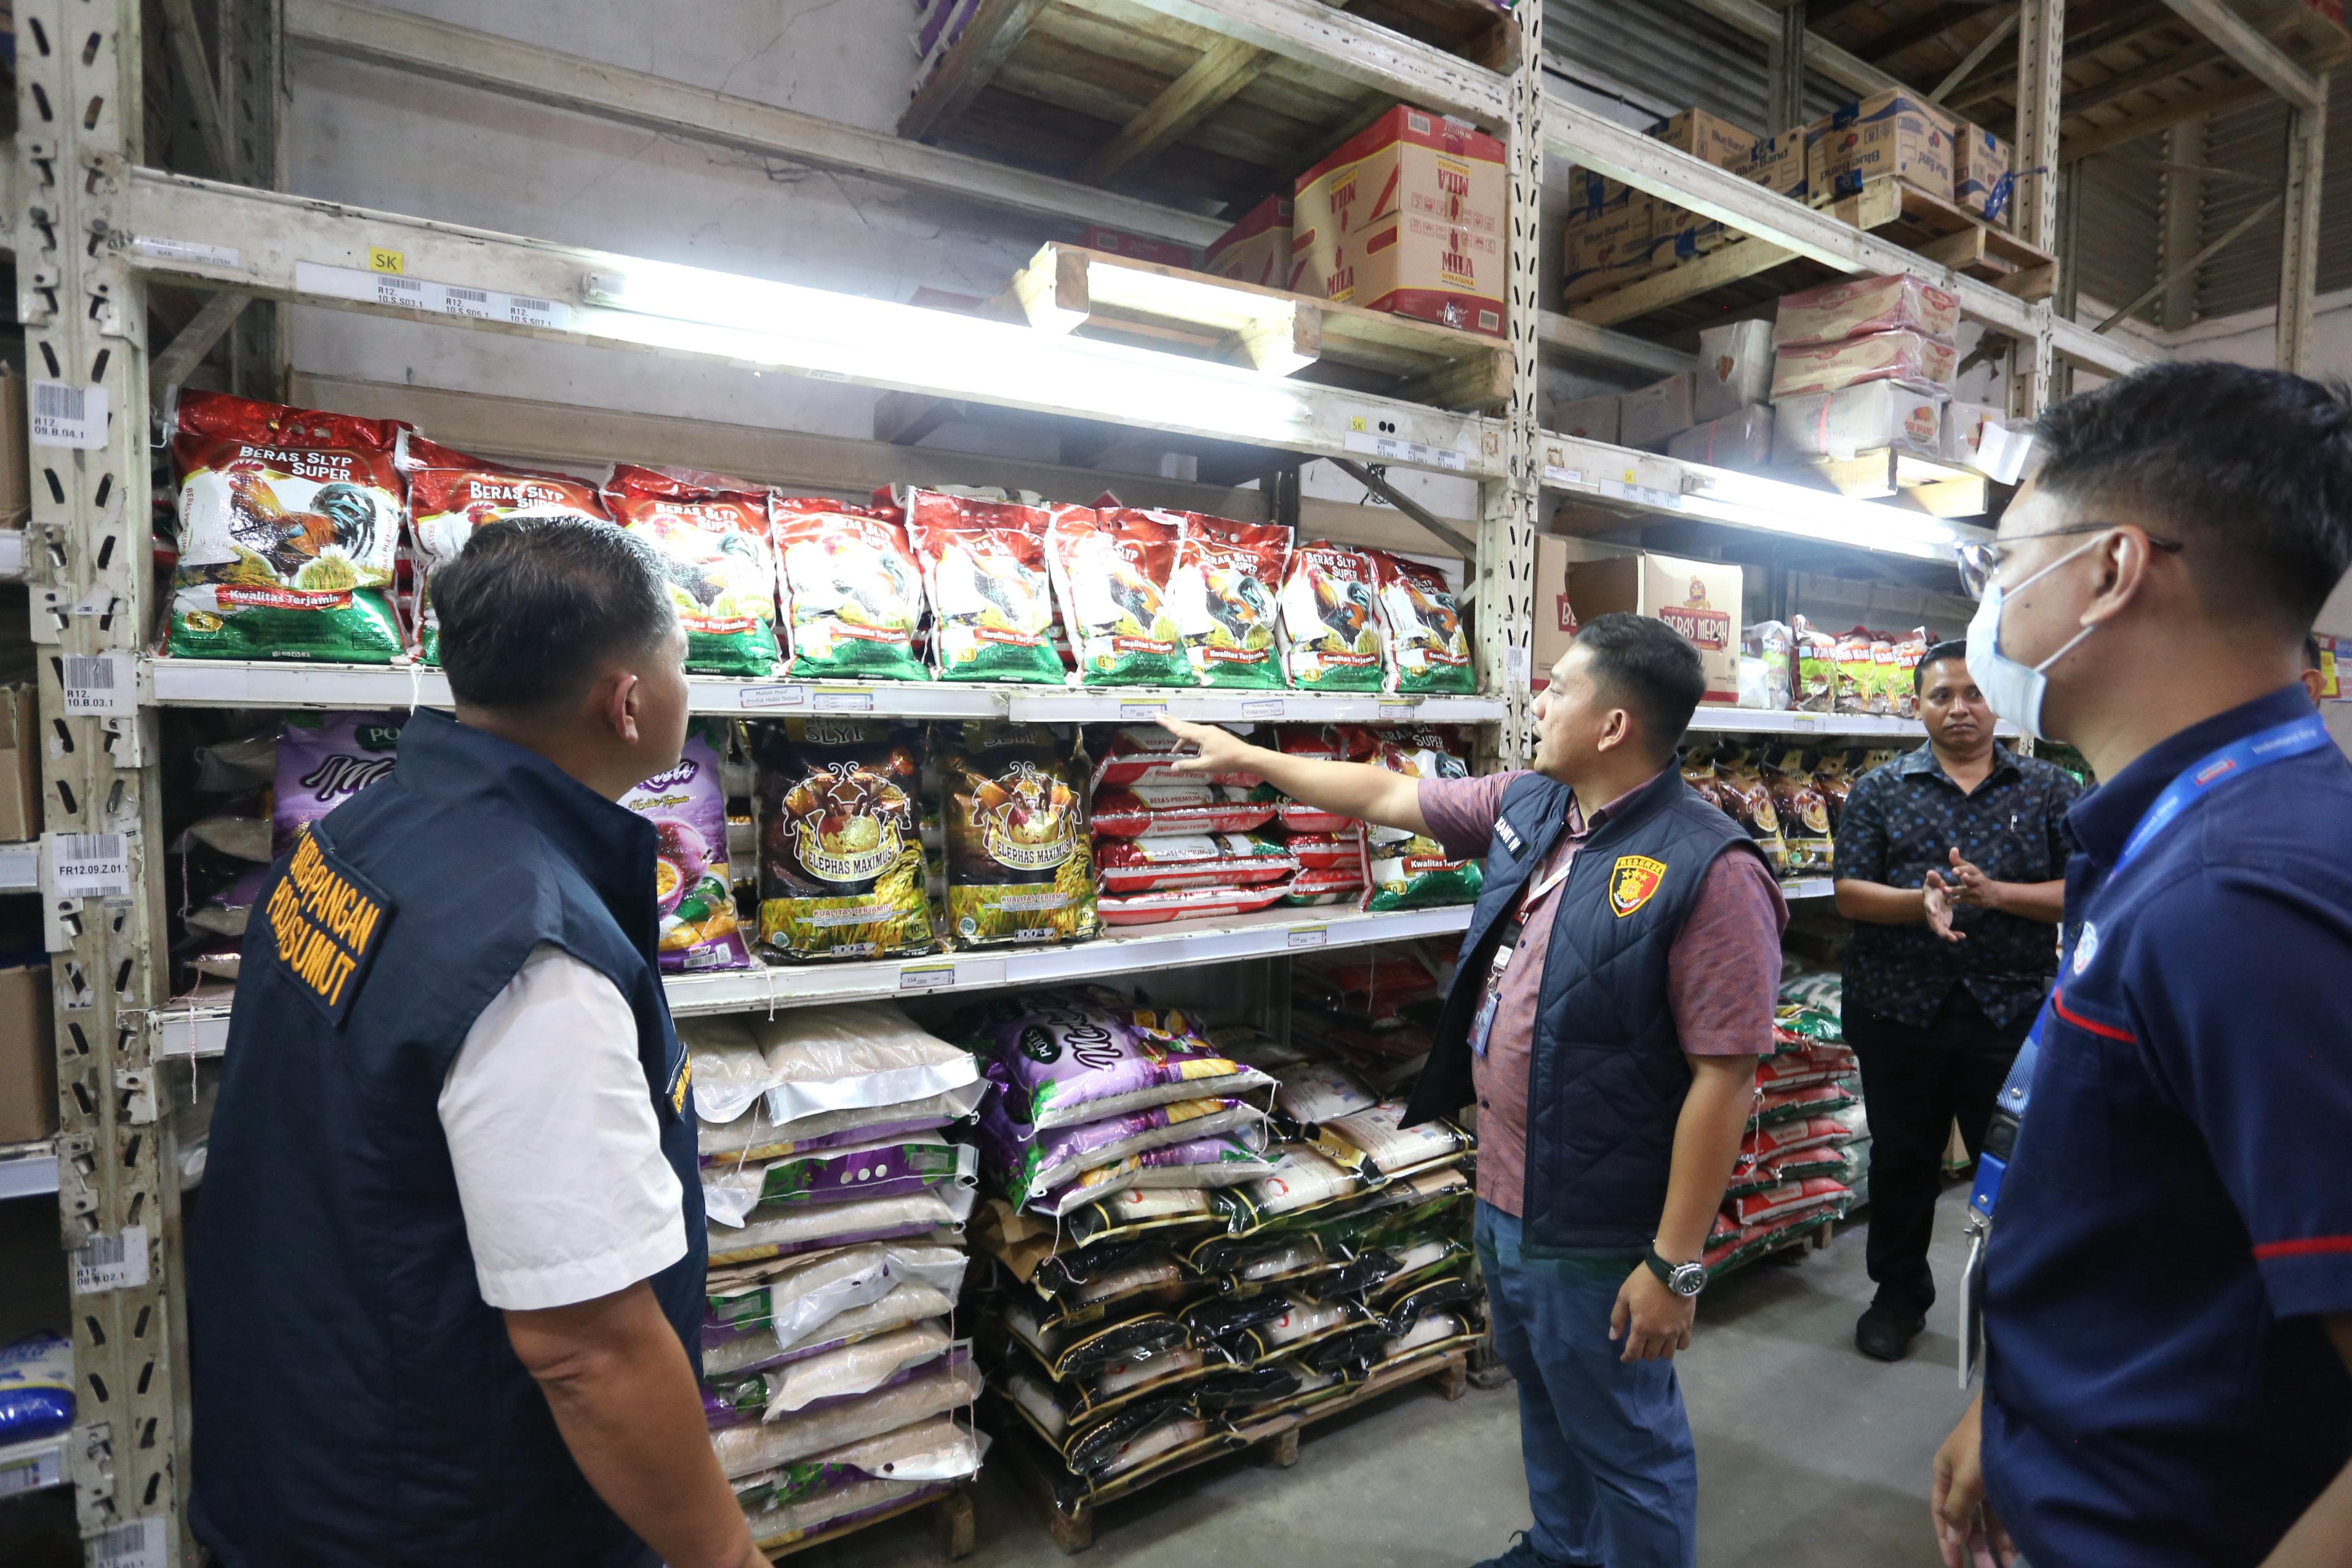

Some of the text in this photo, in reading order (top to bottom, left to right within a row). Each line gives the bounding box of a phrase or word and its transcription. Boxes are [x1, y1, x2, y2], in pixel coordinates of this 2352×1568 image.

[1437, 168, 1469, 197] MILA
[376, 254, 397, 271] SK
[1442, 252, 1474, 278] MILA
[1327, 266, 1354, 296] MILA
[378, 286, 397, 296] R12.
[378, 295, 423, 309] 10.S.S03.1
[446, 298, 464, 307] R12.
[511, 307, 528, 317] R12.
[35, 426, 84, 439] 09.B.04.1
[1353, 421, 1363, 431] SK
[238, 446, 353, 467] BERAS SLYP
[292, 462, 351, 482] SUPER
[470, 480, 565, 502] BERAS SLYP
[655, 503, 738, 521] BERAS SLYP
[697, 516, 739, 532] SUPER
[1233, 552, 1260, 564] SLYP
[1305, 552, 1357, 569] BERAS SLYP
[1229, 560, 1258, 576] SUPER
[1331, 566, 1357, 580] SUPER
[230, 590, 340, 608] Kwalitas Terjamin
[1119, 640, 1149, 650] Kwalitas
[1209, 649, 1265, 661] Kwalitas Terjamin
[1323, 654, 1376, 664] Kwalitas Terjamin
[1413, 735, 1443, 750] SUPER
[997, 839, 1070, 864] ELEPHAS MAXIMUS
[807, 847, 893, 875] ELEPHAS MAXIMUS
[1411, 860, 1444, 869] Kwalitas
[1620, 858, 1663, 874] RESERSE
[59, 864, 128, 876] FR12.09.Z.01.1
[1001, 893, 1068, 903] KUALITAS TERJAMIN
[301, 865, 381, 956] PANGAN
[814, 908, 853, 917] KUALITAS
[854, 906, 892, 915] TERJAMIN
[1080, 912, 1089, 920] 10
[279, 916, 357, 1007] SUMUT
